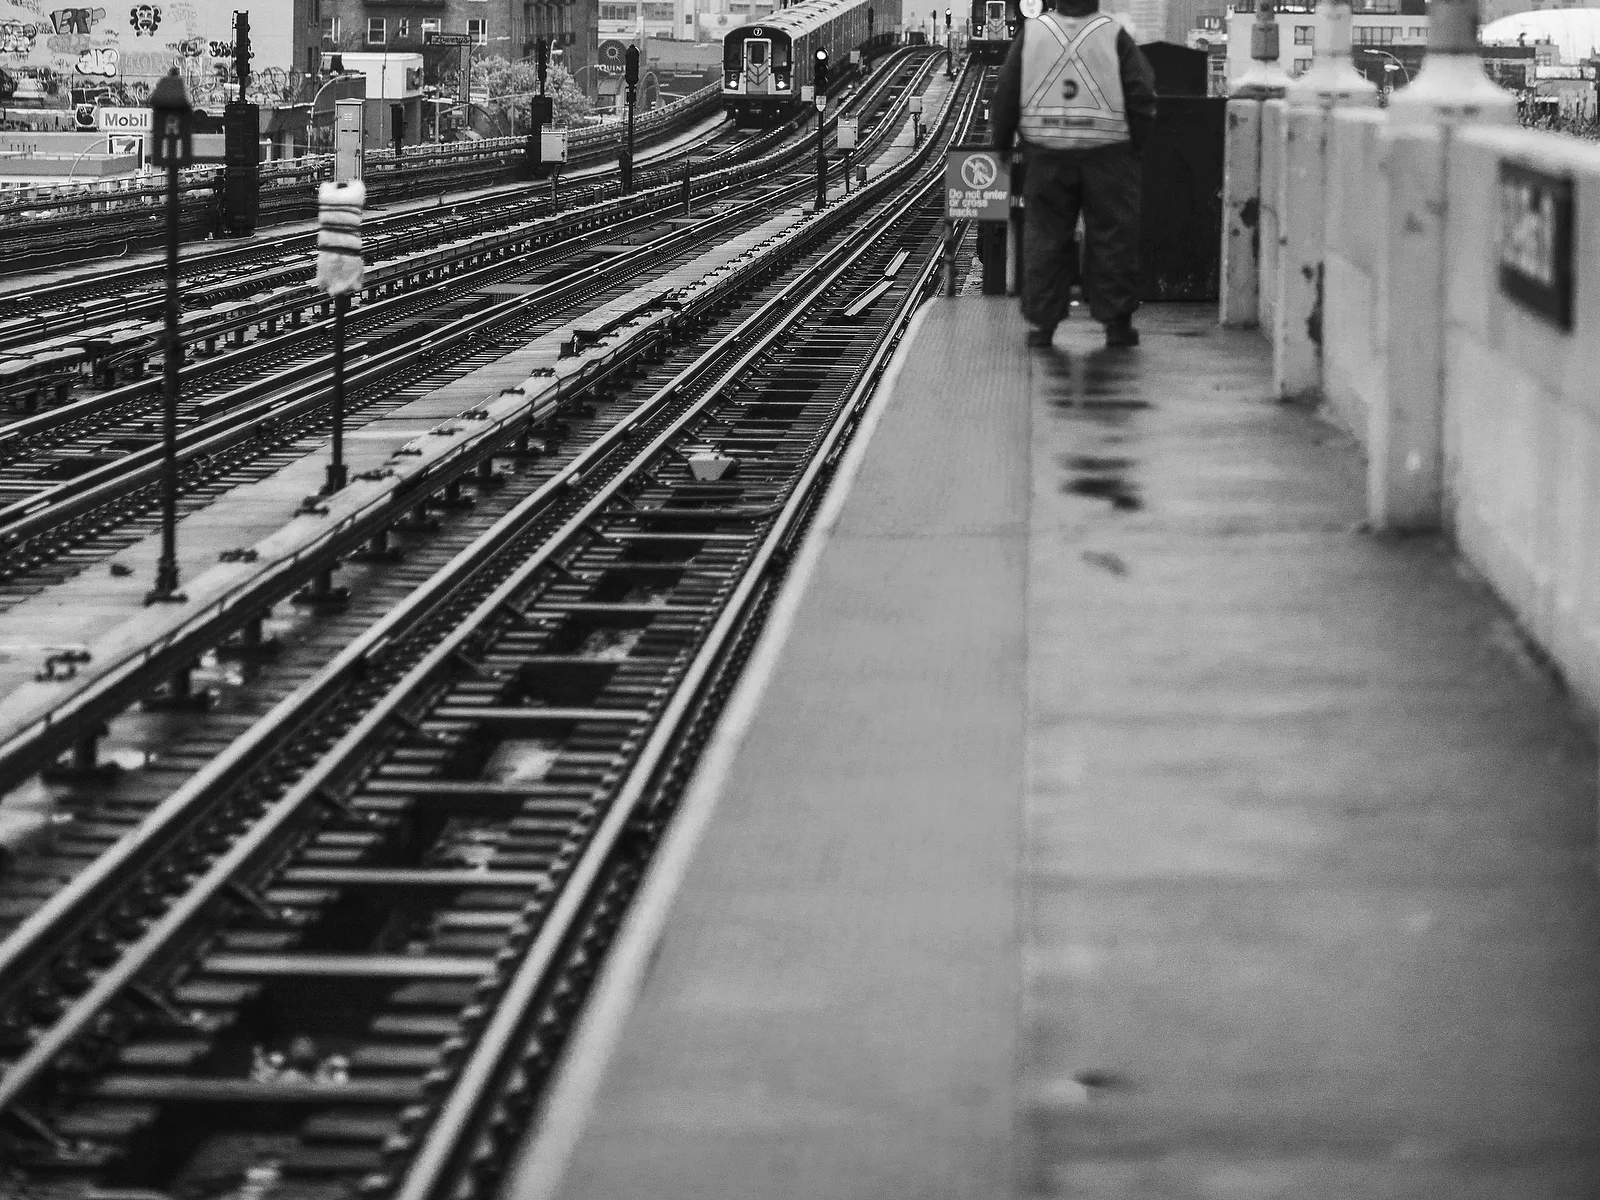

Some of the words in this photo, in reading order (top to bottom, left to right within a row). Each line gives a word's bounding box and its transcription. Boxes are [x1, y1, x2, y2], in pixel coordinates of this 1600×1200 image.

[105, 113, 147, 127] Mobil
[949, 188, 963, 199] Do
[965, 189, 980, 199] not
[983, 189, 1007, 200] enter
[949, 199, 960, 208] or
[962, 199, 988, 208] cross
[949, 207, 978, 217] tracks
